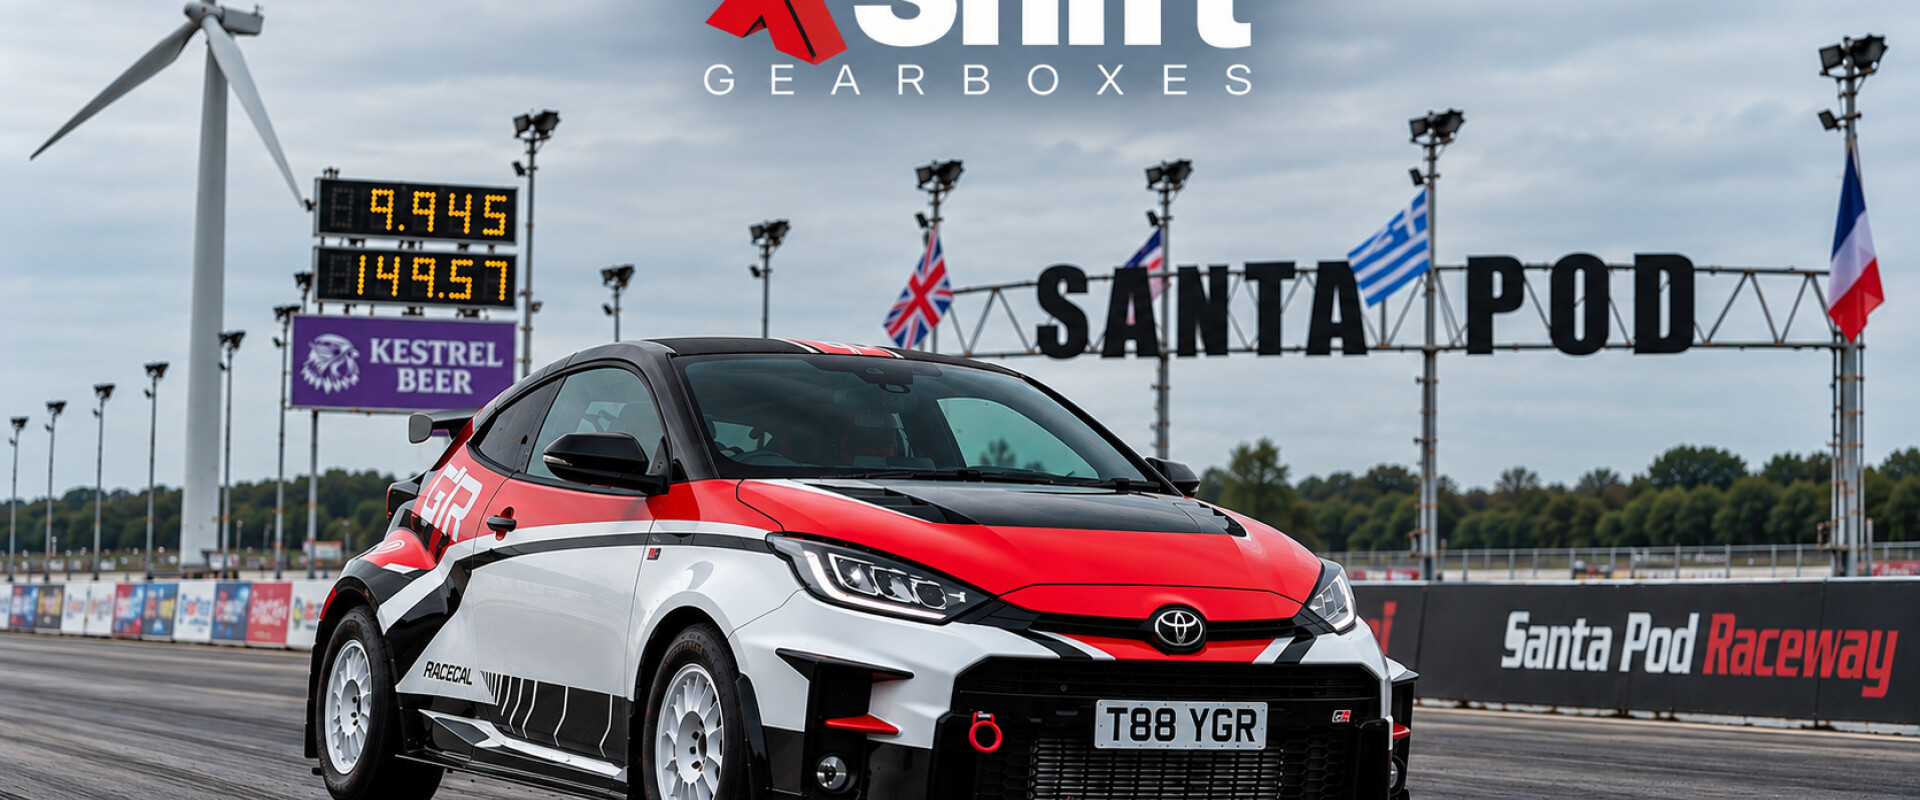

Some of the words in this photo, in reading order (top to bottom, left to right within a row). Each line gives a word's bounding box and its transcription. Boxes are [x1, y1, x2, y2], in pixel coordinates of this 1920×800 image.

[370, 188, 507, 236] 9.945
[357, 254, 507, 301] 149.57
[1037, 261, 1368, 359] SANTA
[1467, 253, 1695, 356] POD
[369, 338, 504, 368] KESTREL
[396, 367, 474, 395] BEER
[420, 463, 483, 542] GR
[423, 660, 473, 686] RACECAL
[1500, 610, 1613, 672] Santa
[1618, 611, 1700, 675] Pod
[1702, 612, 1899, 698] Raceway
[1106, 706, 1177, 742] T88
[1189, 707, 1256, 743] YGR
